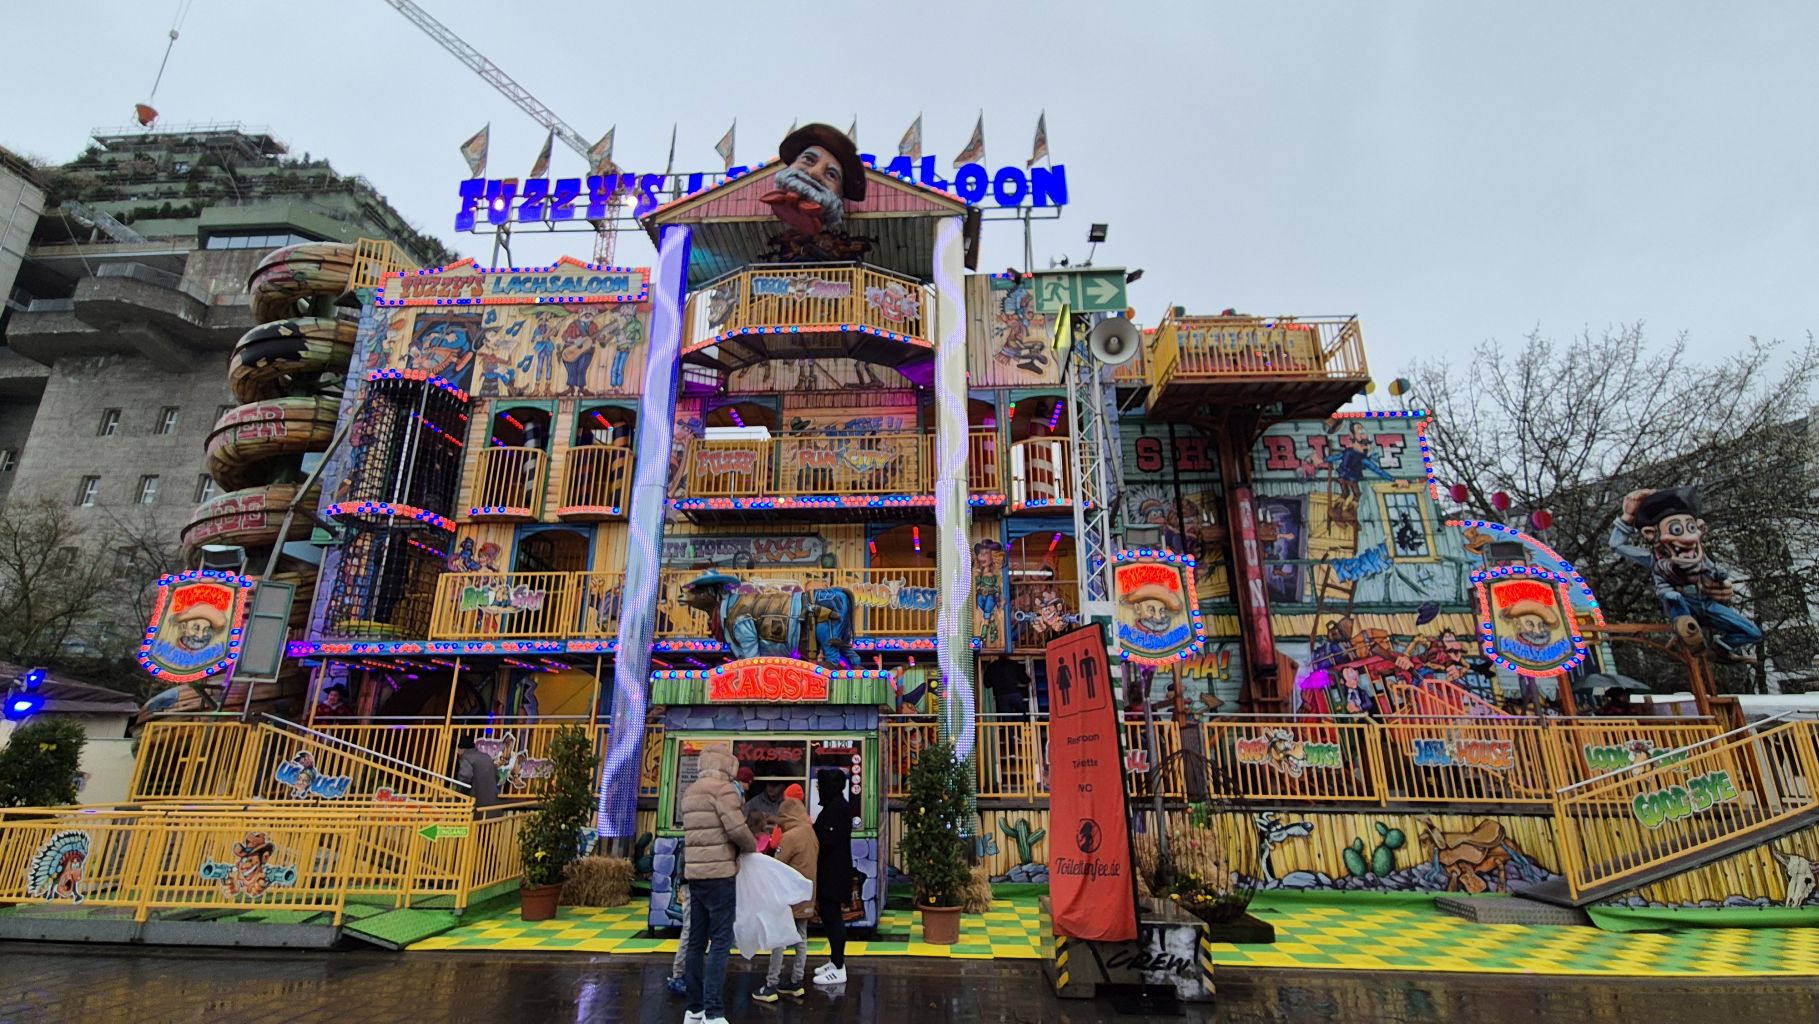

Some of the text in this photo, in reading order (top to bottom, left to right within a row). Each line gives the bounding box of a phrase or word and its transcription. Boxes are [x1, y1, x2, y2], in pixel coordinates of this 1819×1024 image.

[456, 172, 666, 232] FUZZY'S
[400, 274, 631, 298] FUZZY'S LACHSALOON
[1135, 433, 1407, 474] SHRIF
[852, 583, 938, 609] WILD WEST
[1181, 650, 1230, 681] HA!
[710, 667, 827, 700] KASSE
[737, 743, 805, 762] Kasse
[1456, 739, 1514, 769] HOUSE
[1584, 745, 1631, 770] LOOK
[1632, 770, 1740, 830] GOOD BYE
[1106, 949, 1191, 976] CREW
